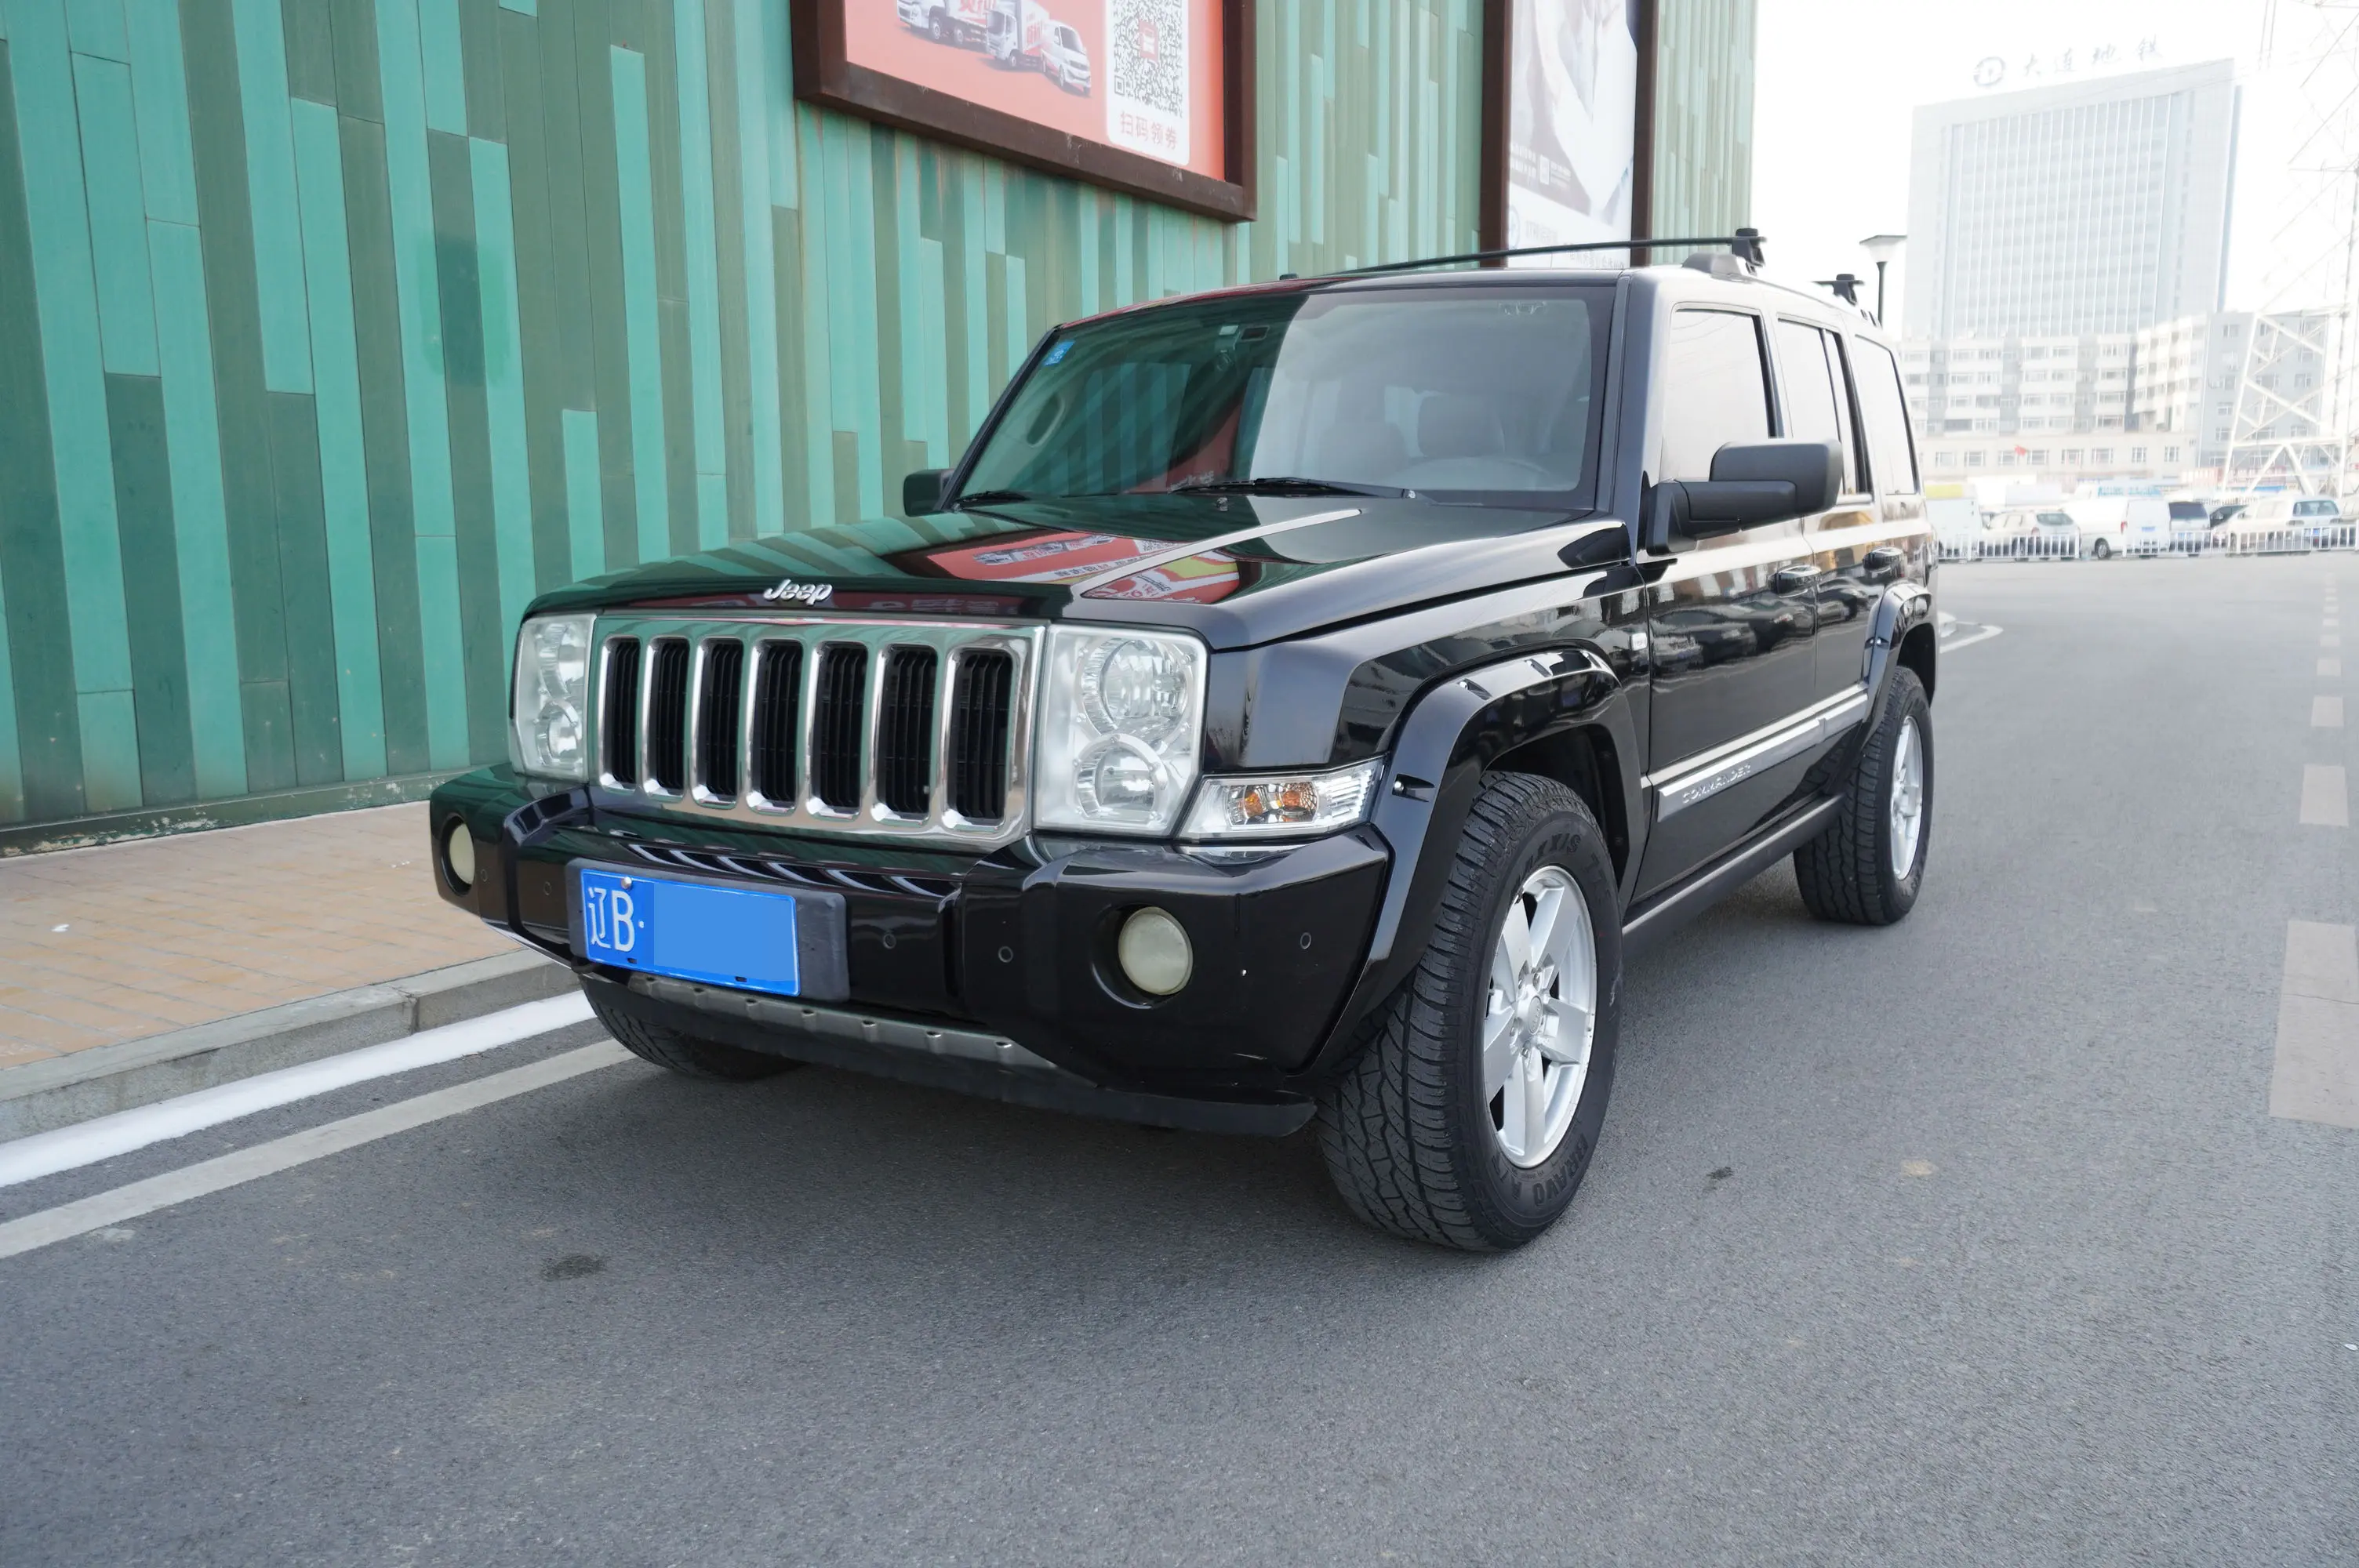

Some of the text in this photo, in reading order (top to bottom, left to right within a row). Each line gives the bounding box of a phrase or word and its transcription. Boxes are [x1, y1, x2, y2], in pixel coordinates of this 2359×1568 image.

[1120, 111, 1177, 150] 扫码领券
[763, 579, 834, 606] Jeep
